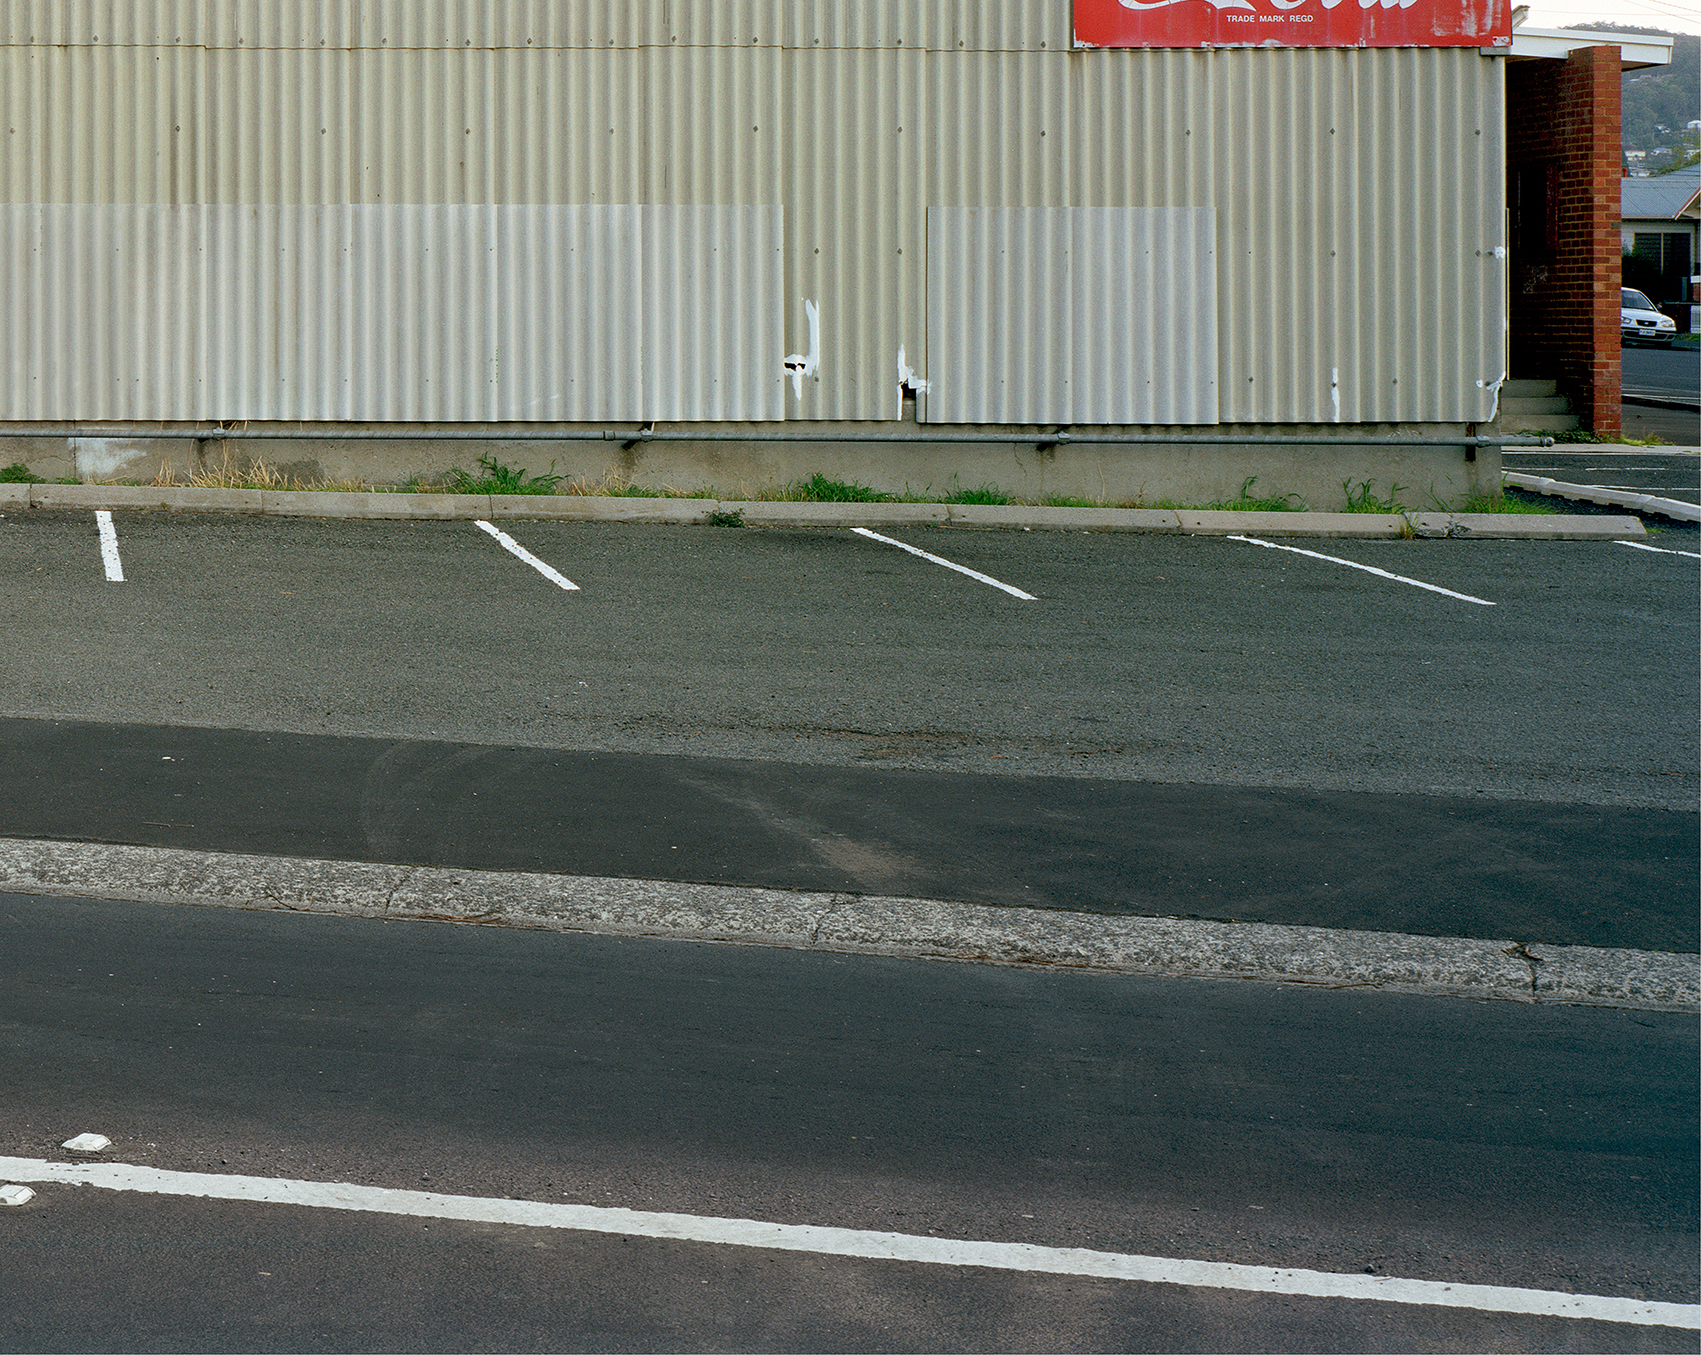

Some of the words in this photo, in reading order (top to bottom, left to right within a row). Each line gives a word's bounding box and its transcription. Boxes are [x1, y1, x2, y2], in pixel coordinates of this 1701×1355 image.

[1226, 14, 1256, 23] TRADE
[1259, 14, 1285, 23] MARK
[1289, 14, 1314, 23] REGD
